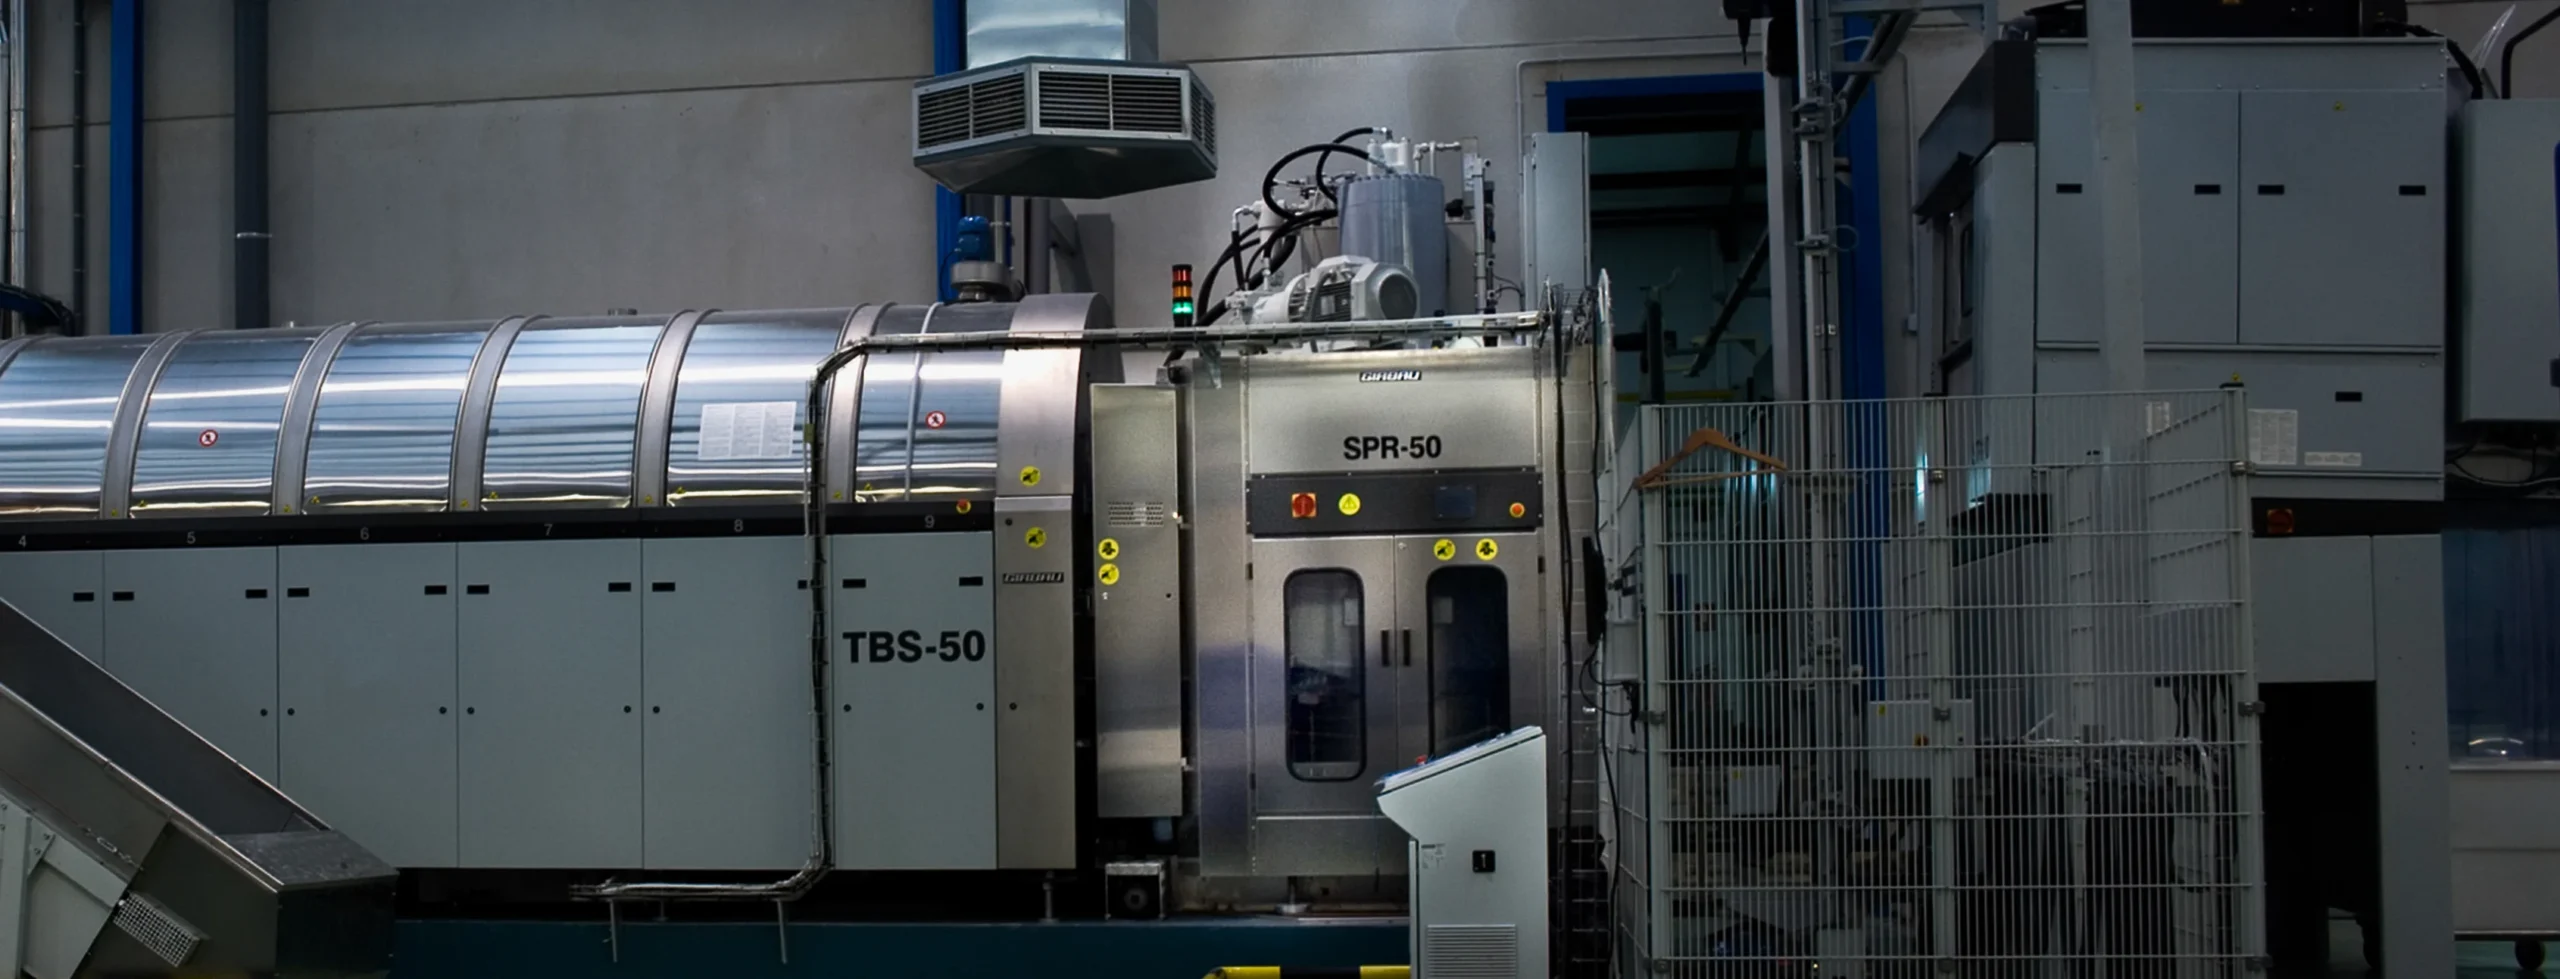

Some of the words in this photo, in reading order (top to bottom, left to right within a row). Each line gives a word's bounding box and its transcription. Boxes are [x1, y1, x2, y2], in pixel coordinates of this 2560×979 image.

[1344, 435, 1442, 460] SPR-50
[733, 518, 744, 532] 8
[924, 515, 935, 529] 9
[359, 527, 370, 540] 6
[543, 523, 554, 536] 7
[18, 534, 27, 547] 4
[186, 531, 197, 544] 5
[842, 629, 986, 664] TBS-50
